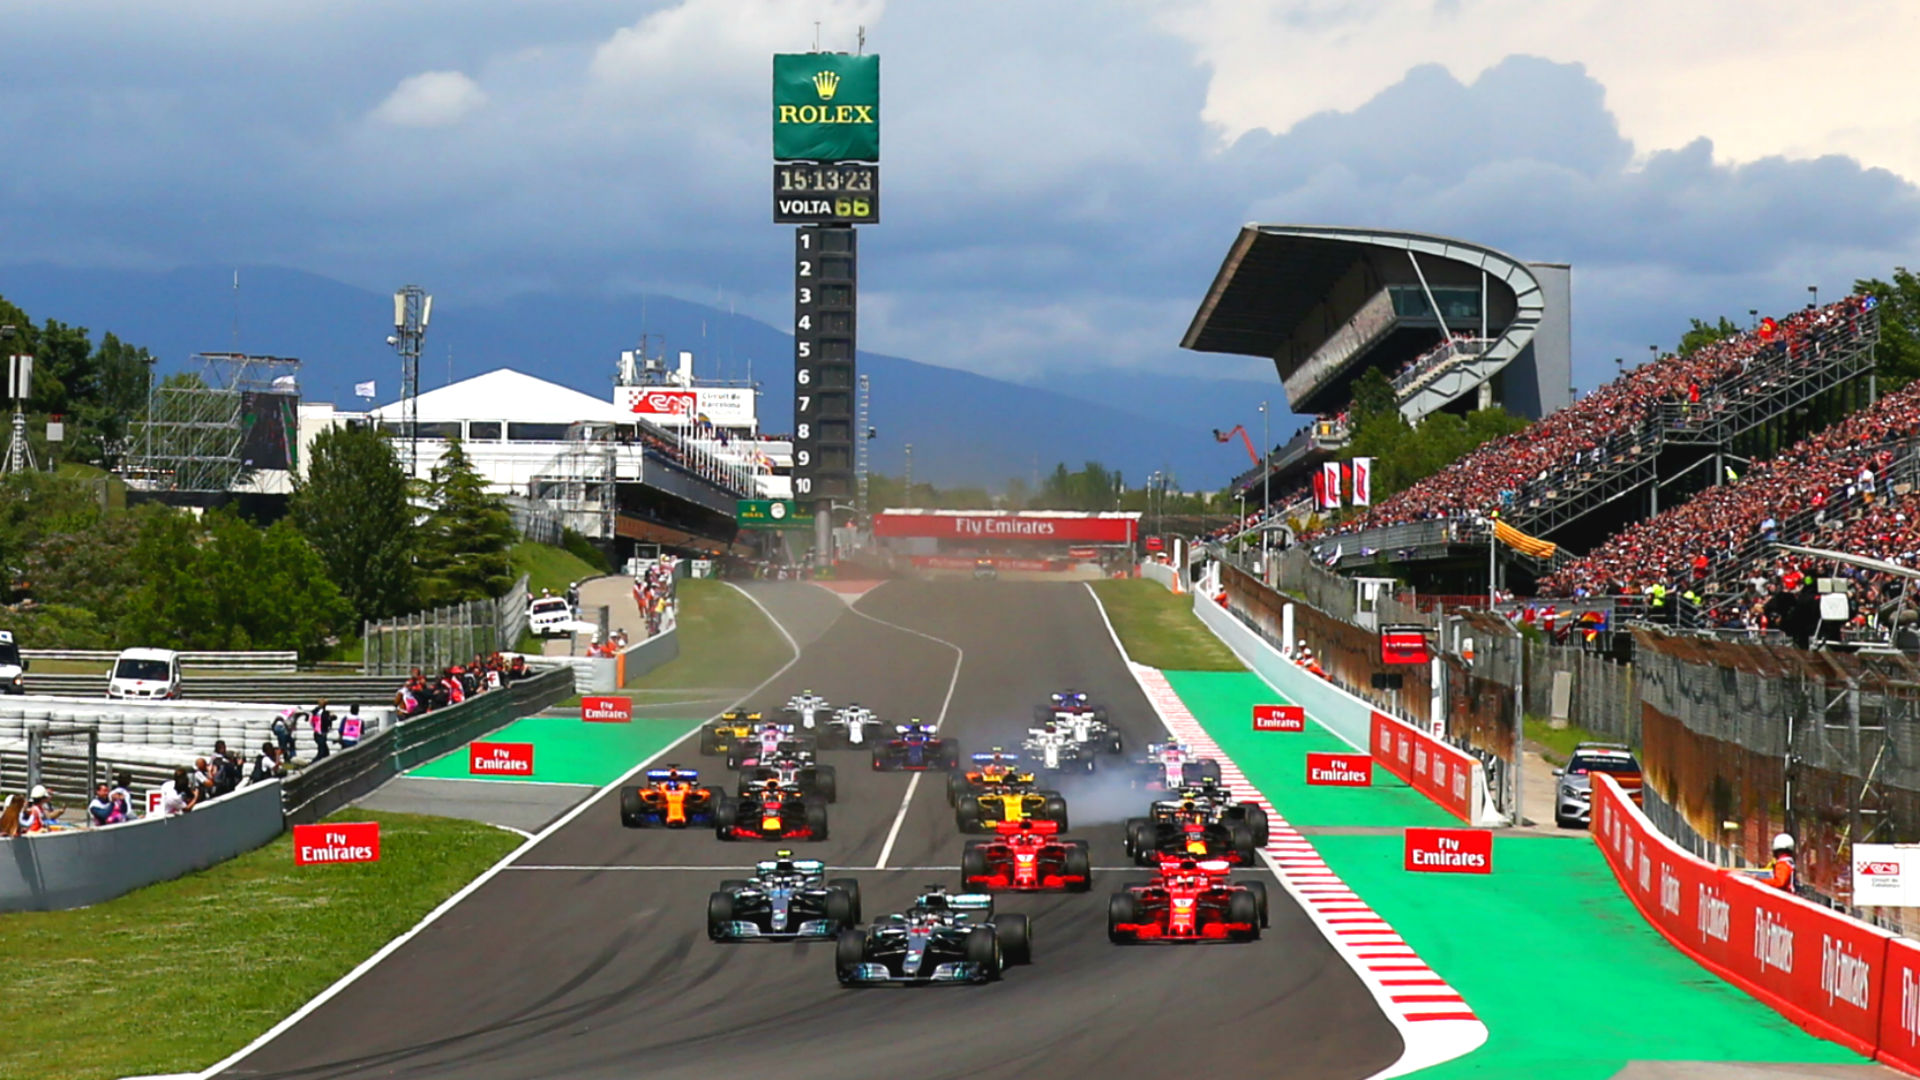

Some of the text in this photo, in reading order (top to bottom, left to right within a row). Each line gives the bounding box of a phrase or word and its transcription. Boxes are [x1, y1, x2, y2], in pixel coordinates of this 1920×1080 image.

[779, 105, 874, 123] ROLEX
[780, 169, 872, 190] 15:13:23
[779, 200, 832, 214] VOLTA
[800, 235, 810, 248] 1
[799, 261, 811, 276] 2
[799, 288, 811, 303] 3
[798, 315, 811, 330] 4
[799, 342, 810, 357] 5
[798, 369, 810, 384] 6
[798, 396, 810, 411] 7
[798, 424, 810, 438] 8
[798, 451, 810, 466] 9
[795, 478, 811, 494] 10
[955, 518, 1054, 535] Fly Emirates
[585, 707, 628, 719] Emirates
[600, 701, 613, 710] Fly
[1272, 710, 1285, 719] Fly
[1257, 717, 1300, 728] Emirates
[1433, 722, 1442, 737] F
[493, 749, 509, 760] Fly
[475, 757, 528, 771] Emirates
[1331, 760, 1347, 770] Fly
[1312, 768, 1366, 782] Emirates
[149, 793, 162, 812] F
[325, 832, 346, 847] Fly
[1438, 837, 1460, 850] Fly
[302, 845, 372, 861] Emirates
[1412, 849, 1485, 866] Emirates
[1821, 934, 1869, 1010] Fly Emirates
